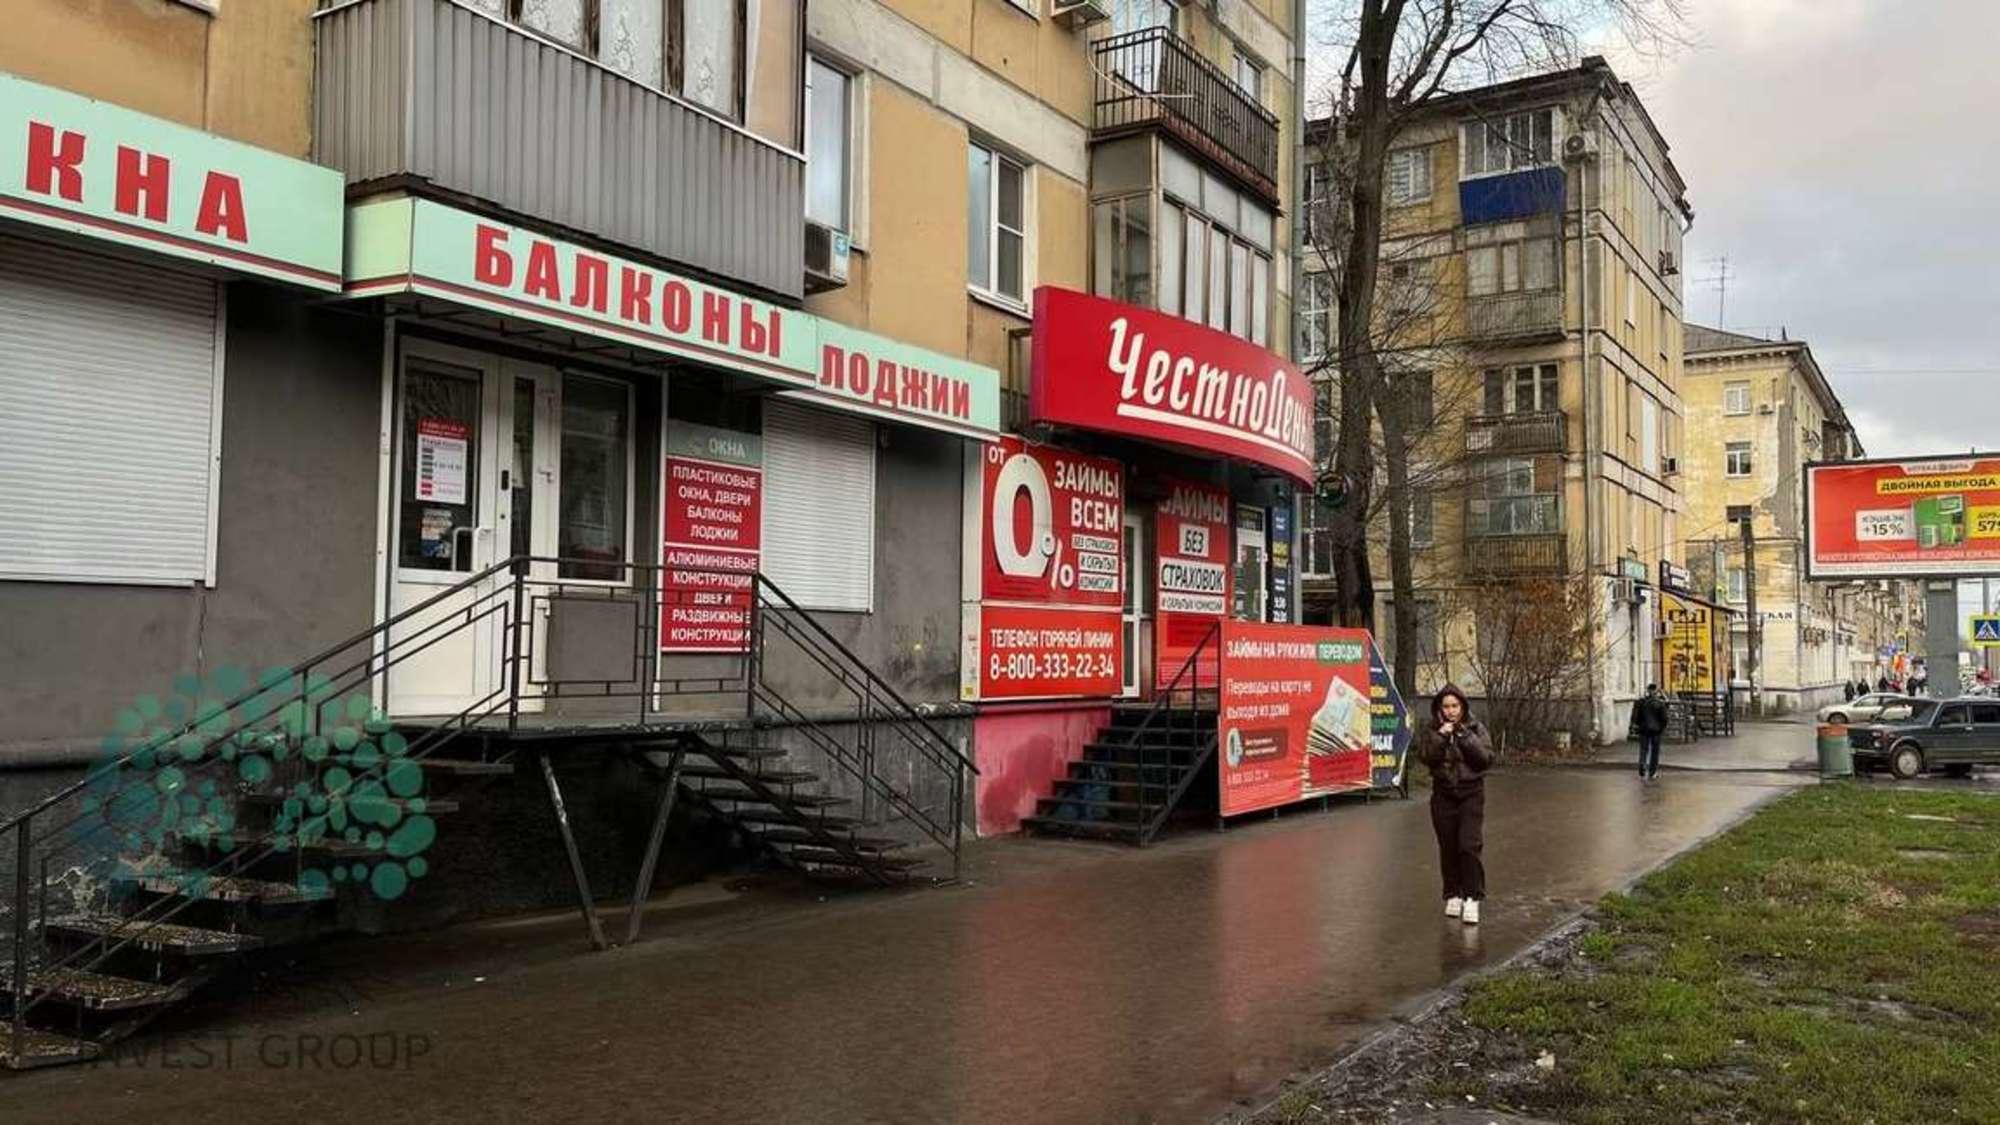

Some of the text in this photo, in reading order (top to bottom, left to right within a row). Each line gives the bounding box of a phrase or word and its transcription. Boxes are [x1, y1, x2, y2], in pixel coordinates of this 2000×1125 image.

[26, 121, 249, 244] КНА
[474, 222, 782, 359] БАЛКОНЫ
[819, 343, 971, 420] ЛОДЖИИ
[708, 437, 747, 459] ОКНА
[673, 466, 756, 489] ПЛАСТИКОВЫЕ
[1054, 460, 1119, 499] ЗАЙМЫ
[1881, 479, 1996, 492] ДВОЙНАЯ ВЫГОДА
[678, 486, 752, 506] ОКНА, ДВЕРИ
[687, 506, 743, 525] БАЛКОНЫ
[1071, 497, 1119, 533] ВСЕМ
[690, 525, 739, 542] ЛОДЖИИ
[1864, 525, 1904, 536] +15%
[1184, 529, 1204, 554] БЕЗ
[667, 552, 757, 571] АЛЮМИНИЕВЫЕ
[672, 572, 752, 588] КОНСТРУКЦИИ
[1162, 563, 1224, 591] СТРАХОВОК
[694, 592, 732, 605] ДВЕРИ
[672, 608, 751, 625] РАЗДВИЖНЫЕ
[990, 628, 1114, 649] ТЕЛЕФОН ГОРЯЧЕЙ ЛИНИИ
[1227, 638, 1261, 658] ЗАЙМЫ
[990, 653, 1114, 680] 8-800-333-22-34
